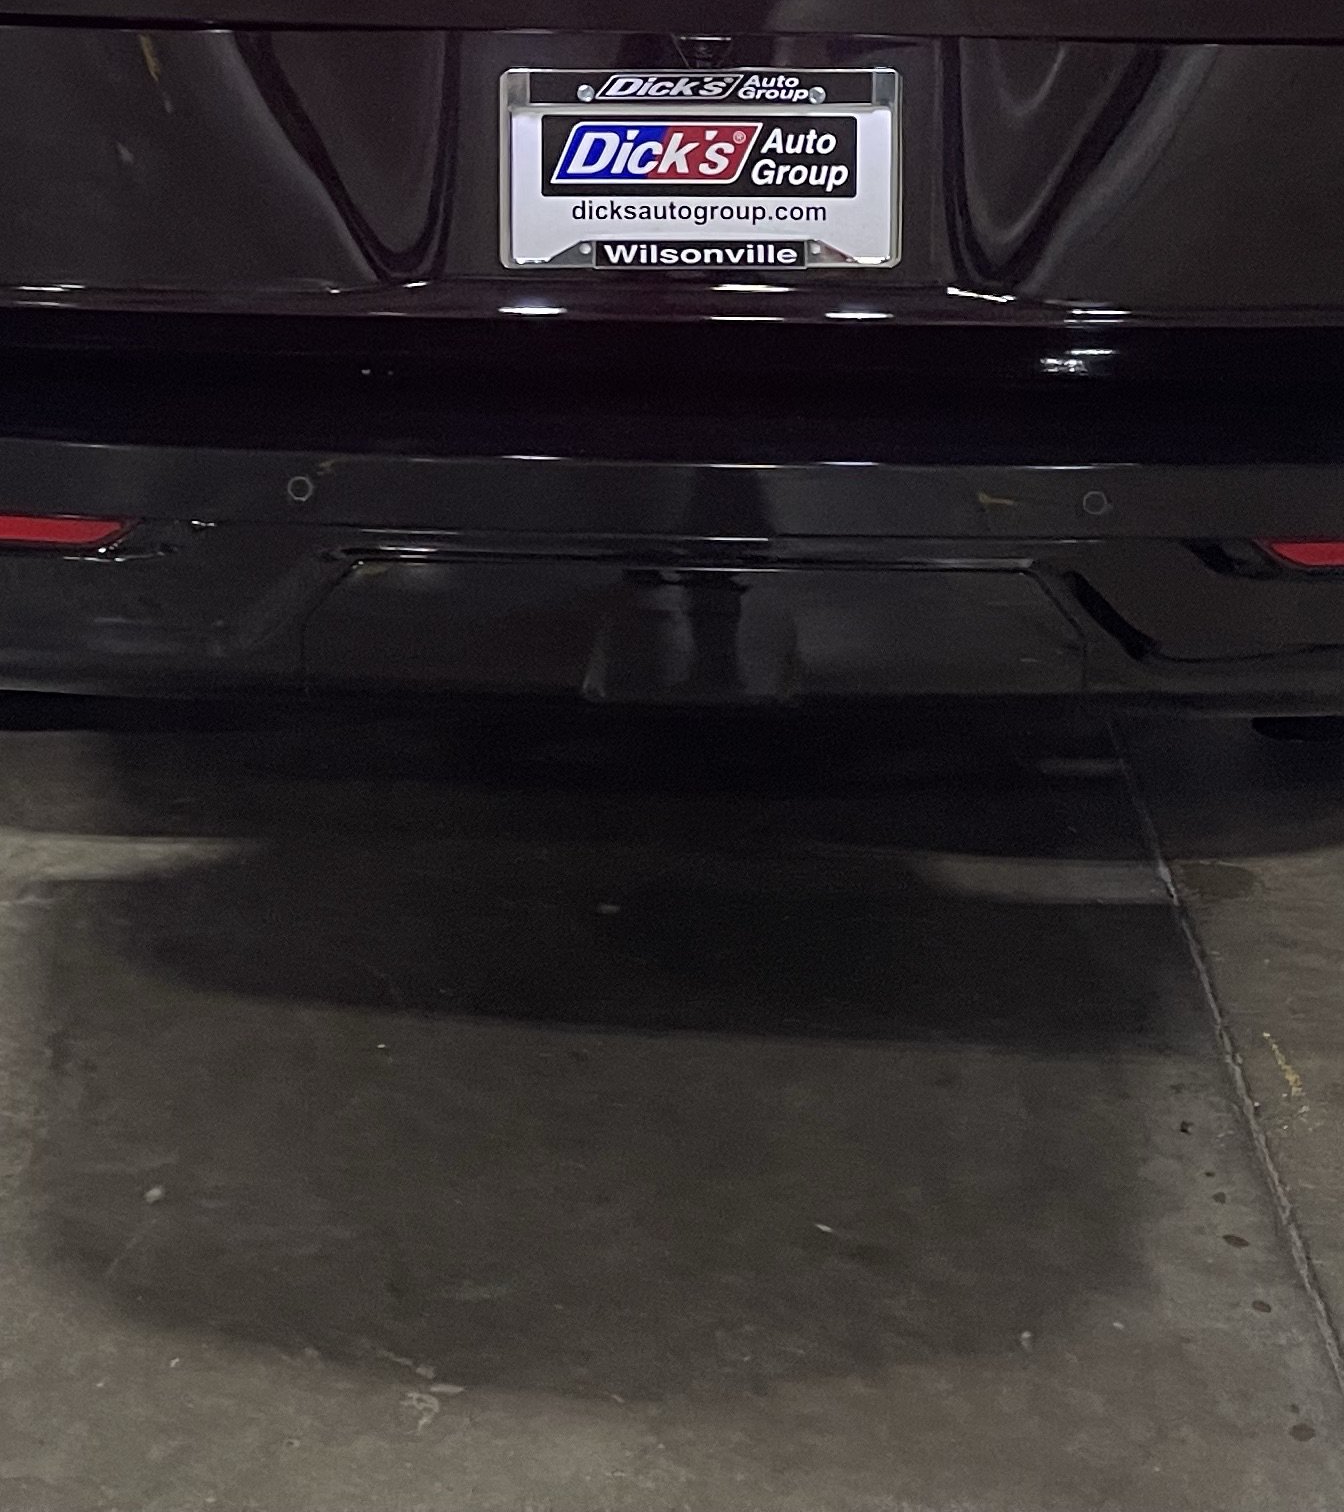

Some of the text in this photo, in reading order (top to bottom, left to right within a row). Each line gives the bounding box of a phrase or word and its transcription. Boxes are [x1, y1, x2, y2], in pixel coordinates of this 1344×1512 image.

[744, 75, 799, 88] Auto
[738, 86, 809, 102] Group
[760, 128, 836, 155] Auto
[751, 159, 848, 192] Group
[572, 200, 827, 225] dicksautogroup.com
[604, 244, 798, 265] Wilsonville
